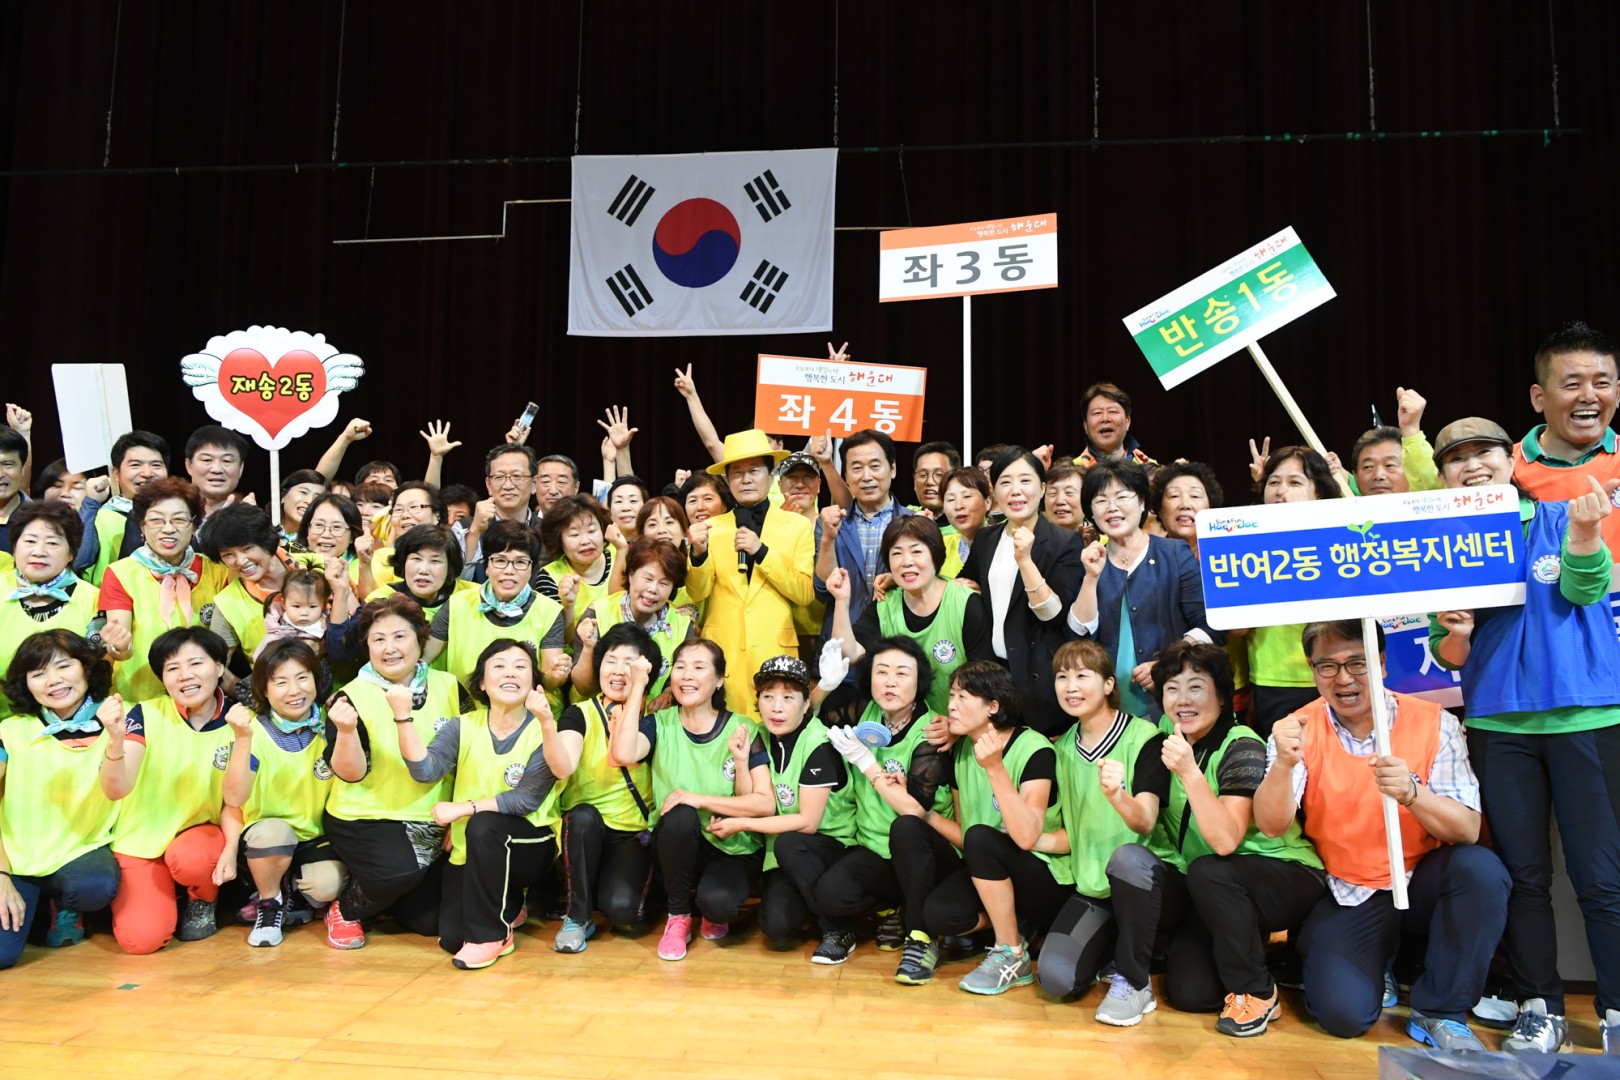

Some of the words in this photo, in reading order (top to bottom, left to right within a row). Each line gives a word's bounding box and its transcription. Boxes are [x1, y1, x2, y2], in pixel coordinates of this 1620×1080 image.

[1010, 219, 1047, 233] 해운대
[1158, 261, 1298, 358] 반송1동
[230, 371, 314, 402] 재송2동
[805, 373, 828, 384] 행복한
[830, 375, 846, 384] 도시
[849, 370, 893, 387] 해운대
[1453, 491, 1503, 511] 해운대
[1209, 520, 1258, 533] Haeundae
[1209, 546, 1322, 588] 반여2동
[1329, 530, 1515, 579] 행정복지센터
